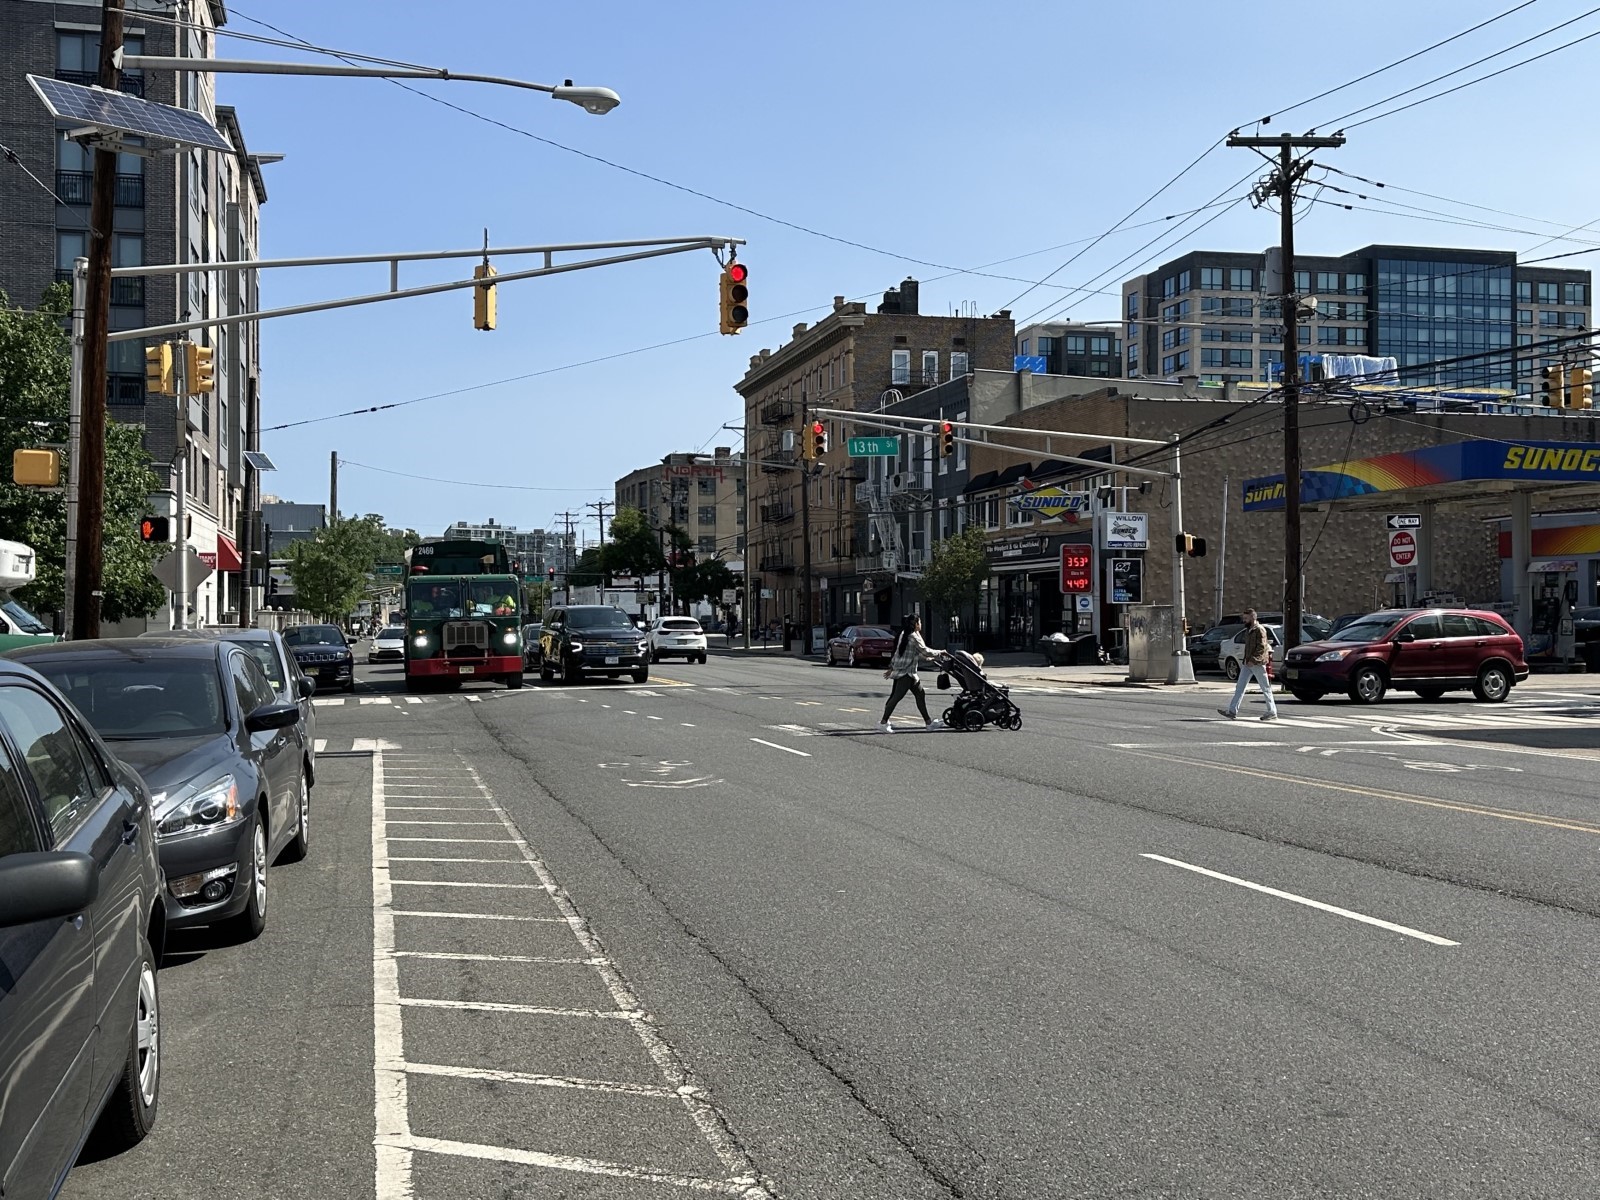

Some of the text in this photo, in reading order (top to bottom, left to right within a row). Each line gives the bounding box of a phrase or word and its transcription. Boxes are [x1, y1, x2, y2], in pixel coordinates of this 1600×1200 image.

[853, 441, 879, 453] 13th
[1503, 447, 1600, 472] SUNOC
[1022, 496, 1082, 508] SUNOCO
[1395, 552, 1411, 560] ENTER
